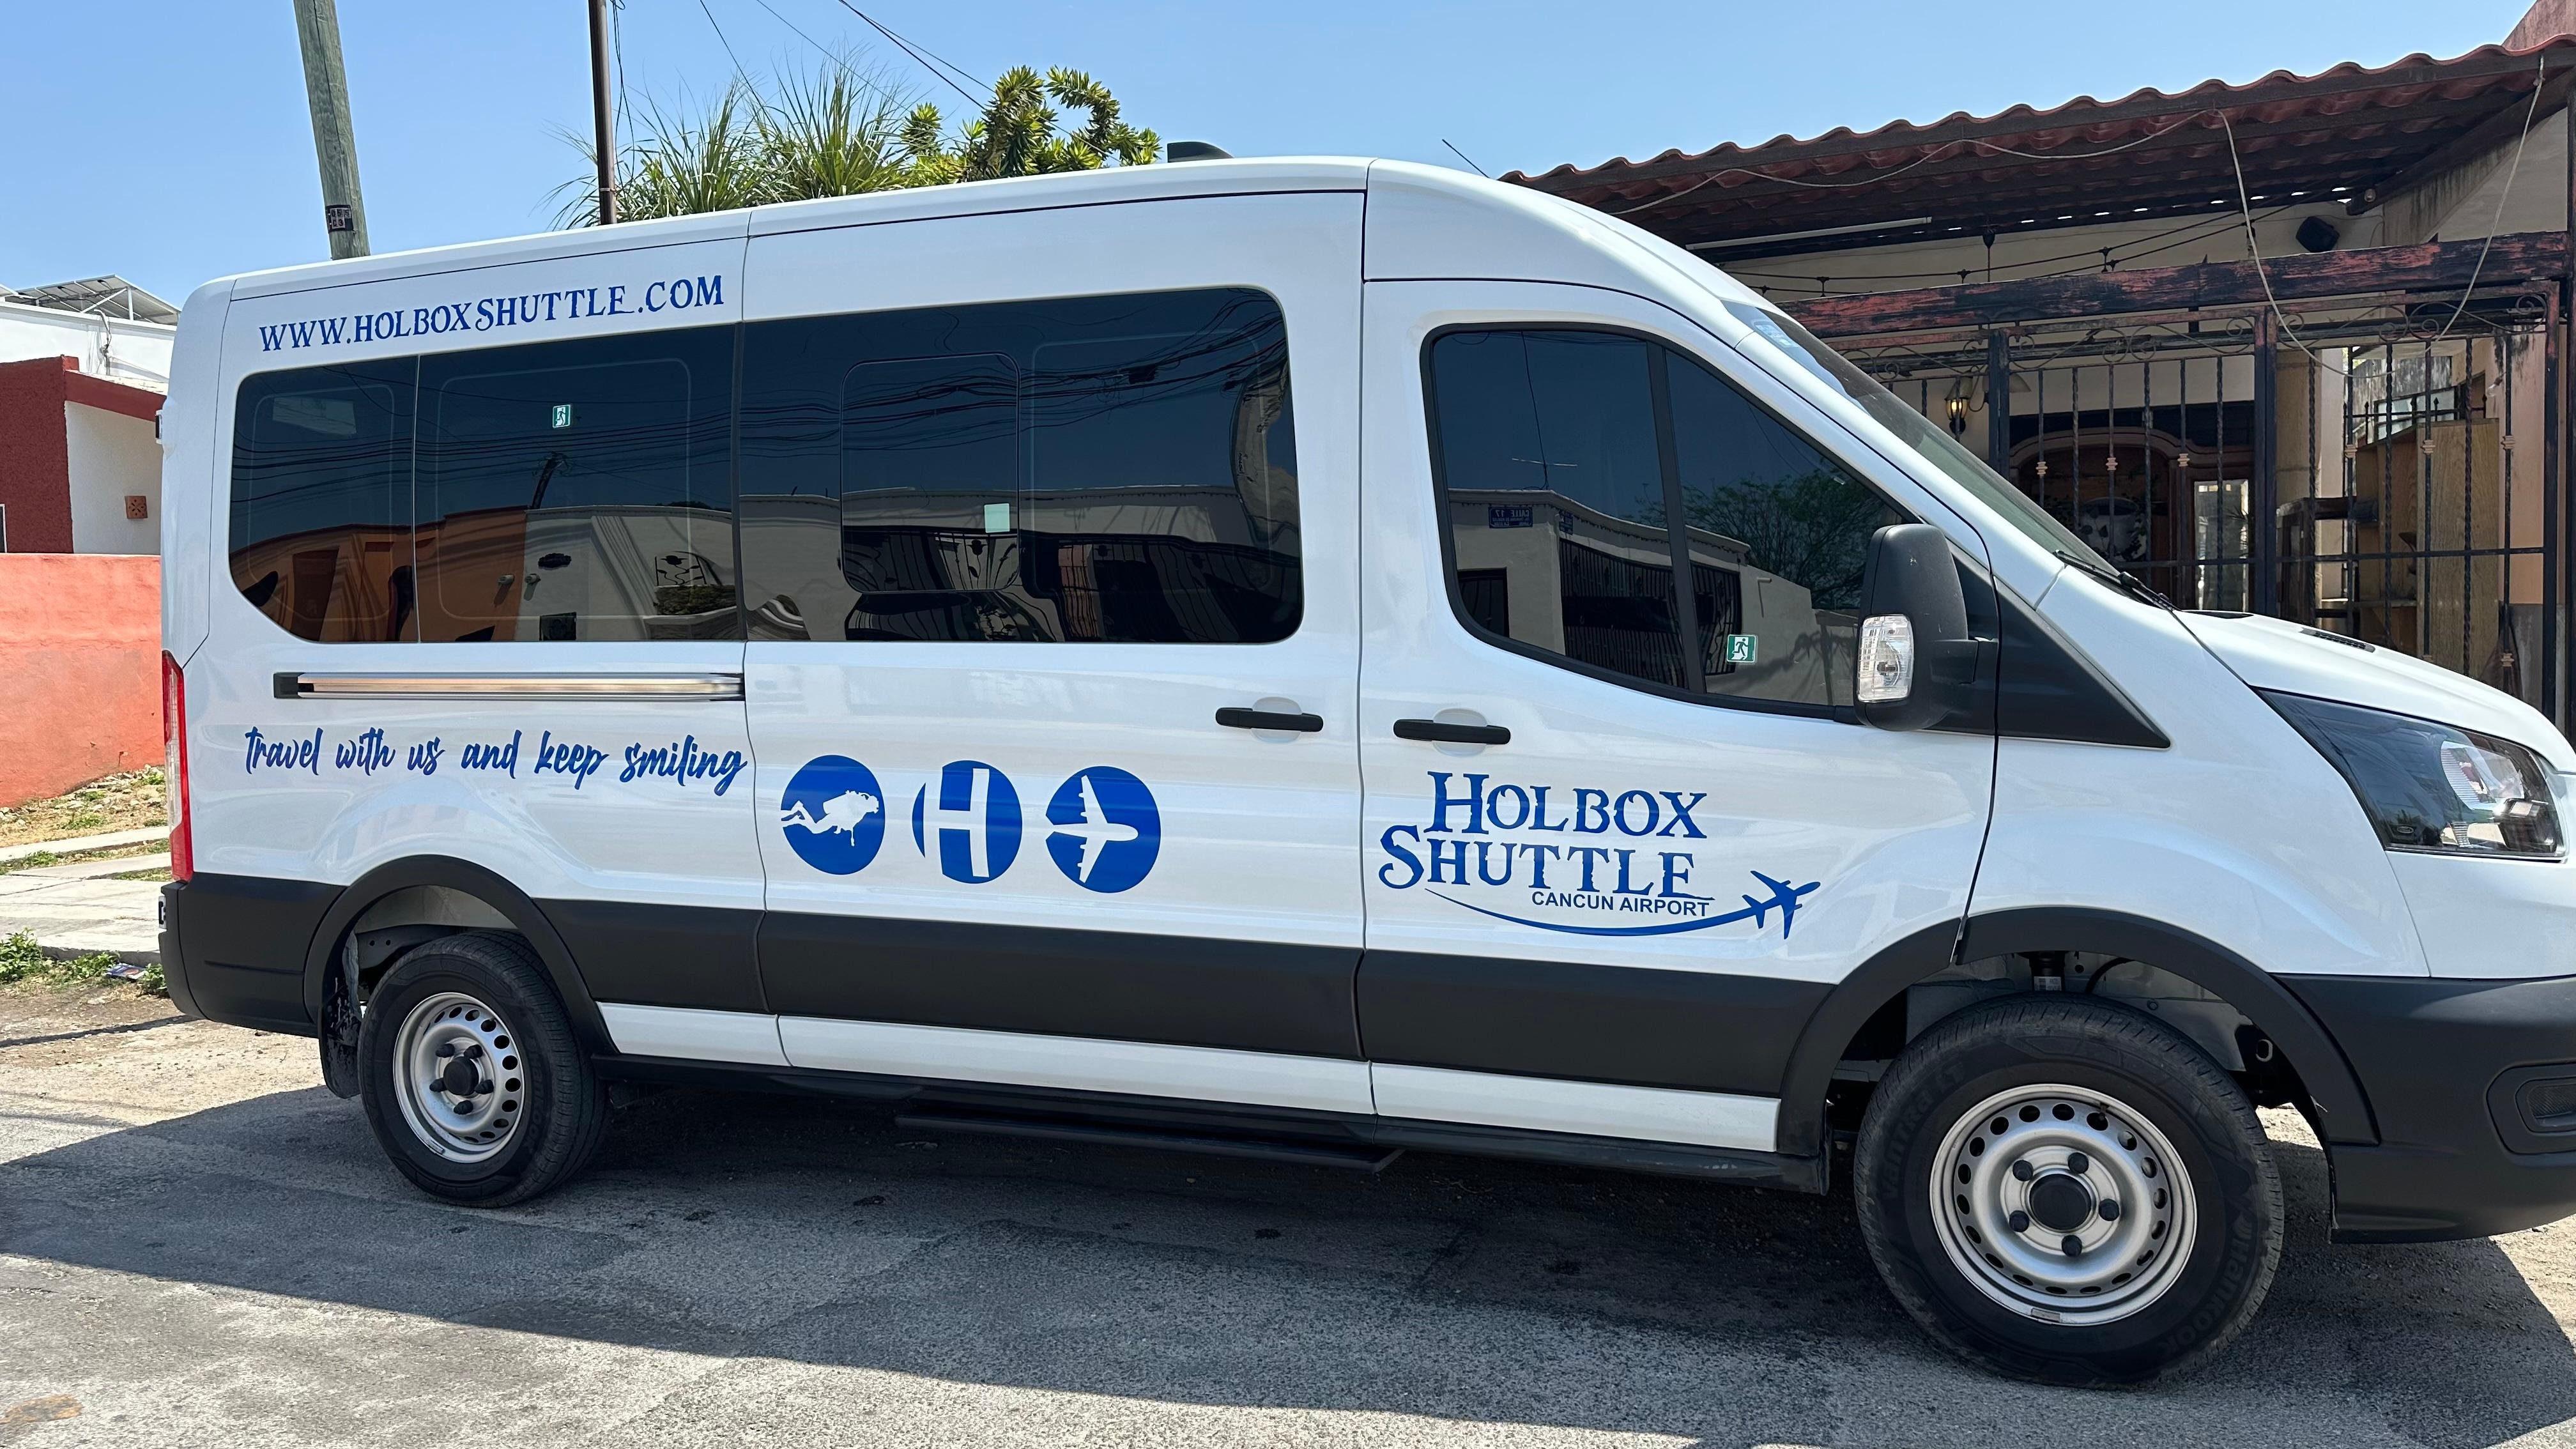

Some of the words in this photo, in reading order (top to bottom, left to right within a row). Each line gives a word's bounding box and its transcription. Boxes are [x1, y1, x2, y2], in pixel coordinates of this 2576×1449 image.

[259, 275, 724, 352] WWW.HOLBOXSHUTTLE.COM
[245, 726, 323, 776] travel
[335, 727, 396, 776] with
[407, 737, 445, 776] us
[461, 730, 522, 779] and
[533, 730, 609, 790] keep
[619, 735, 748, 797] smiling
[1423, 771, 1707, 839] HOLBOX
[1378, 825, 1715, 901] SHUTTLE
[1531, 891, 1614, 910] CANCUN
[1619, 897, 1710, 917] AIRPORT
